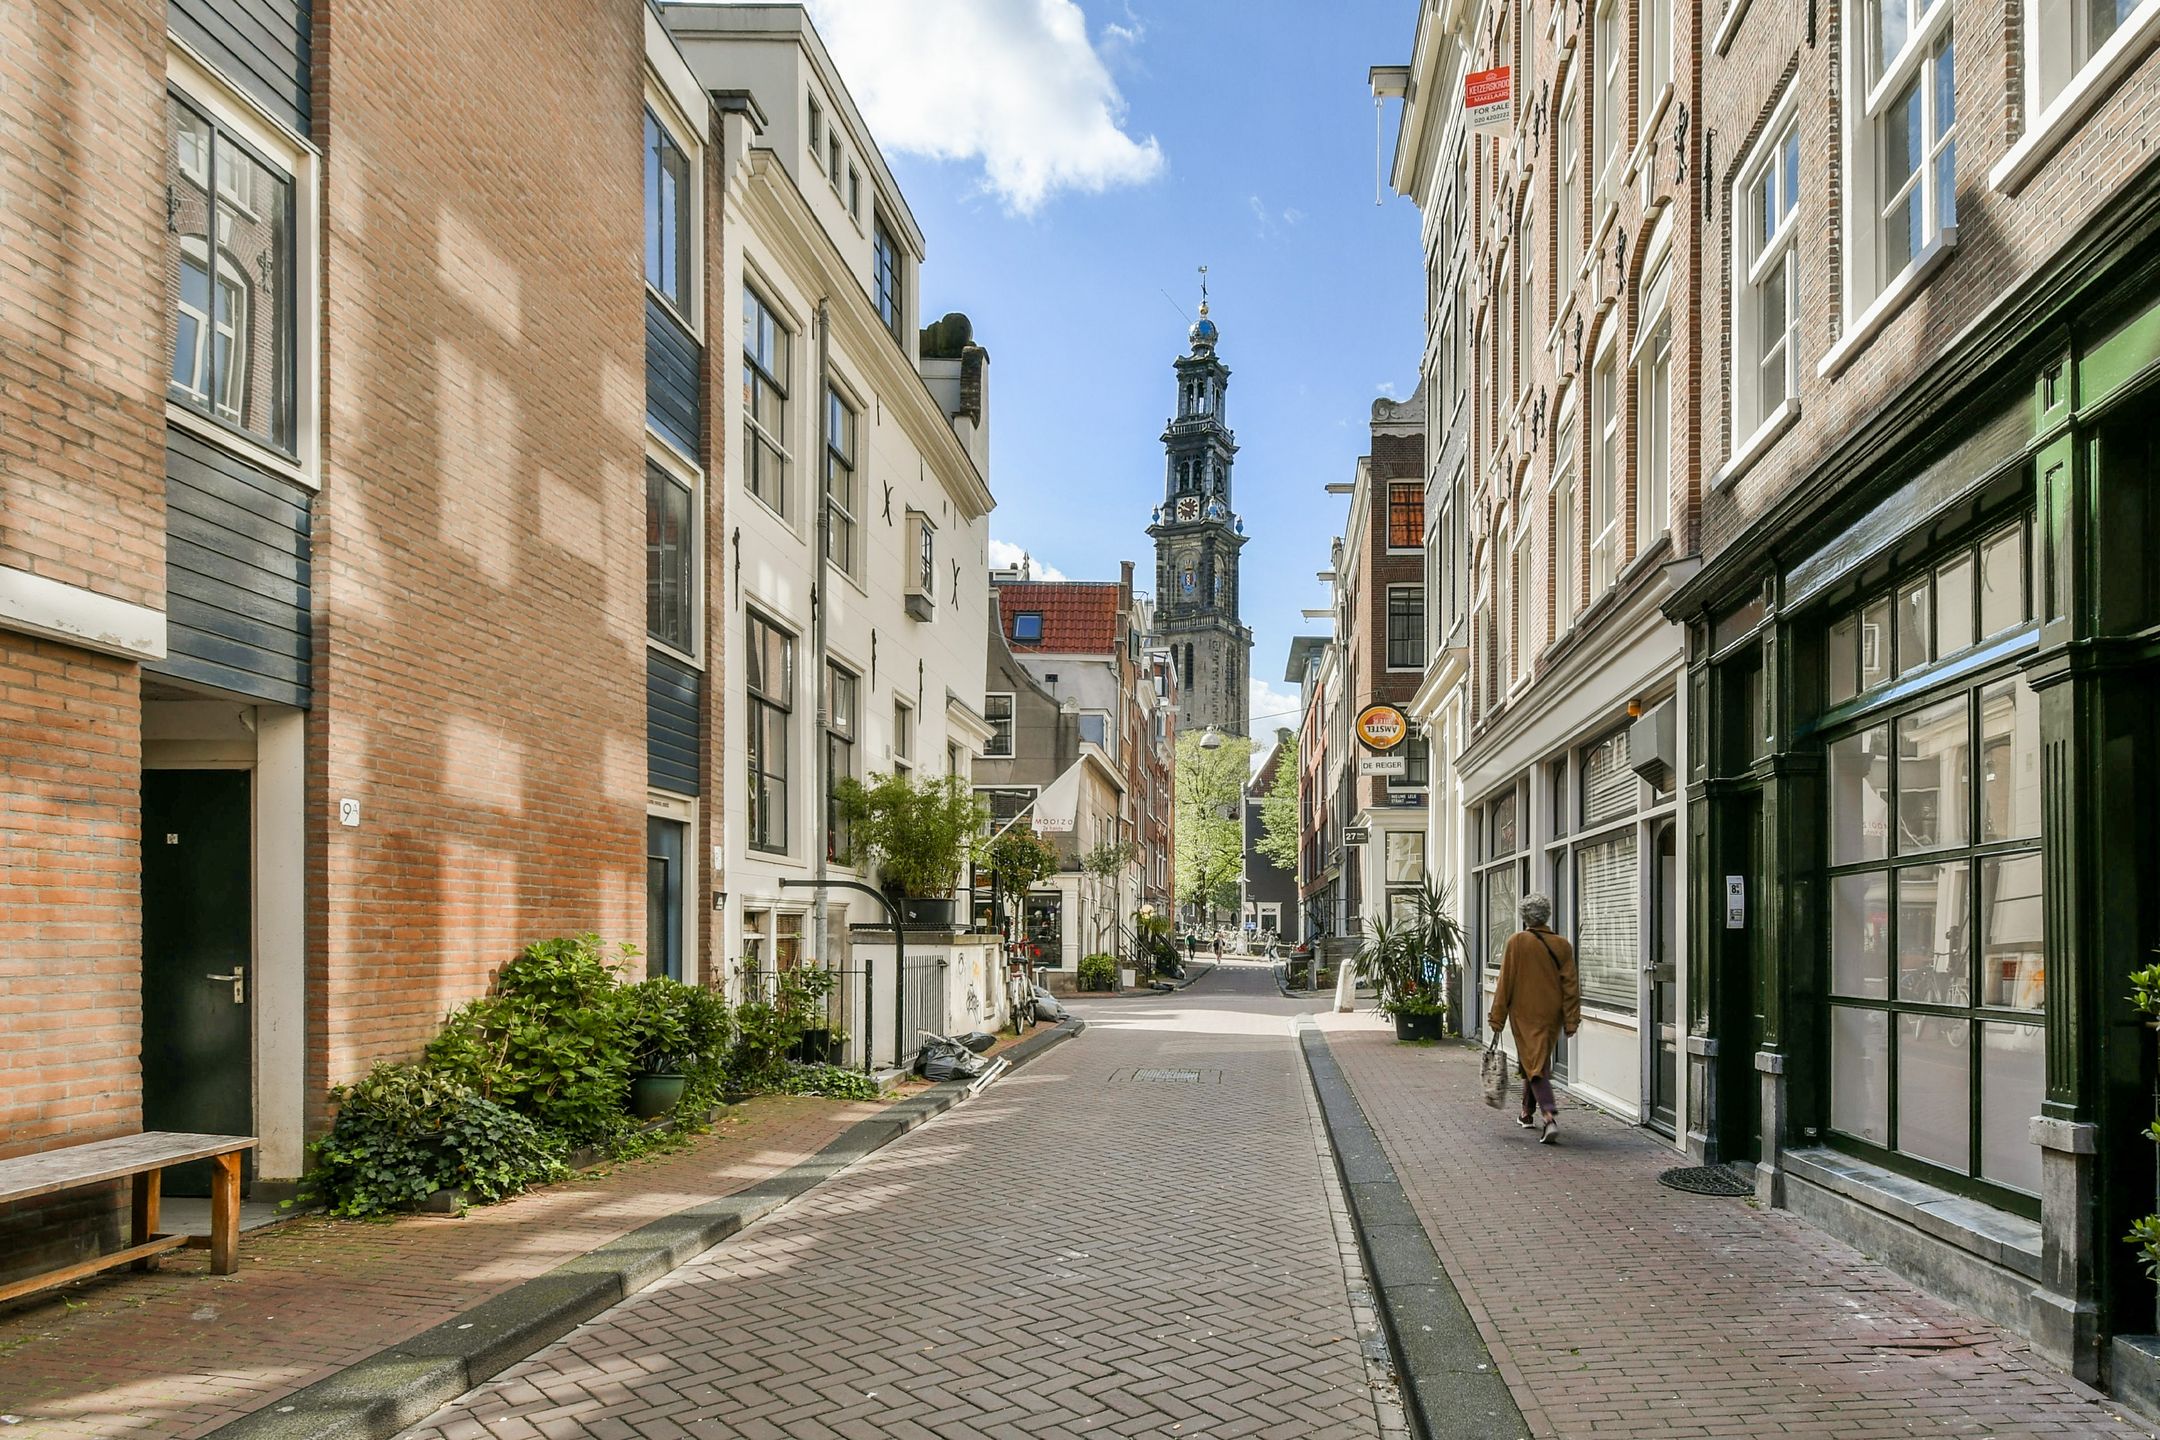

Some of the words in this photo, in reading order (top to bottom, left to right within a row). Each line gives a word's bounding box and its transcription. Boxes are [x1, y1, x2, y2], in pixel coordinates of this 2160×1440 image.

[1474, 106, 1489, 116] FOR
[1491, 102, 1510, 112] SALE
[1366, 725, 1398, 733] AMSTEL
[1375, 761, 1402, 769] REIGER
[1345, 832, 1356, 841] 27
